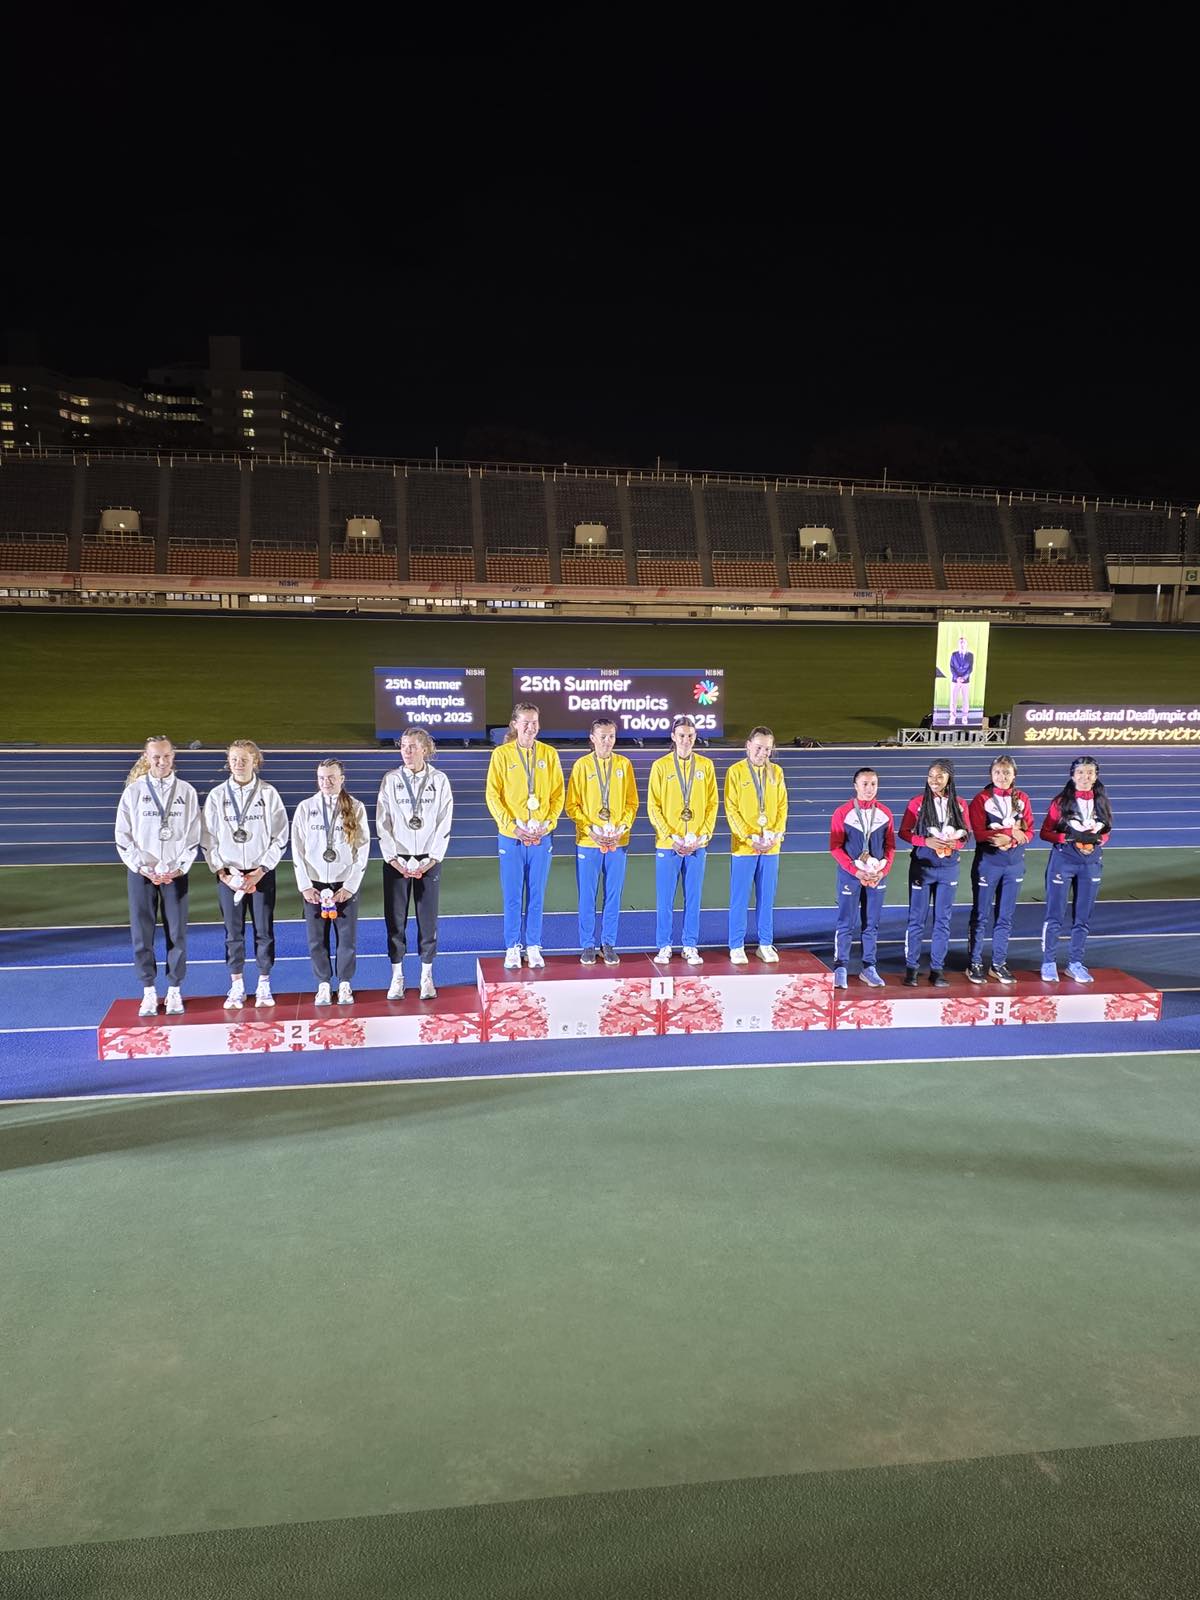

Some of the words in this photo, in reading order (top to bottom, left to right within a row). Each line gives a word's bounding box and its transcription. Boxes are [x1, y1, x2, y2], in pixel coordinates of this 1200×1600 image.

[600, 669, 620, 677] NISHI
[705, 669, 724, 677] NISHI
[385, 678, 412, 690] 25th
[414, 679, 462, 691] Summer
[520, 675, 561, 692] 25th
[564, 676, 632, 692] Summer
[395, 694, 465, 709] Deaflympics
[568, 695, 668, 712] Deaflympics
[406, 711, 442, 725] Tokyo
[443, 712, 473, 723] 2025
[620, 714, 670, 731] Tokyo
[1025, 709, 1054, 722] Gold
[1055, 709, 1102, 722] medalist
[1102, 709, 1125, 722] and
[1126, 709, 1187, 724] Deaflympic
[660, 981, 665, 995] 1
[995, 1001, 1005, 1014] 3
[292, 1025, 302, 1039] 2
